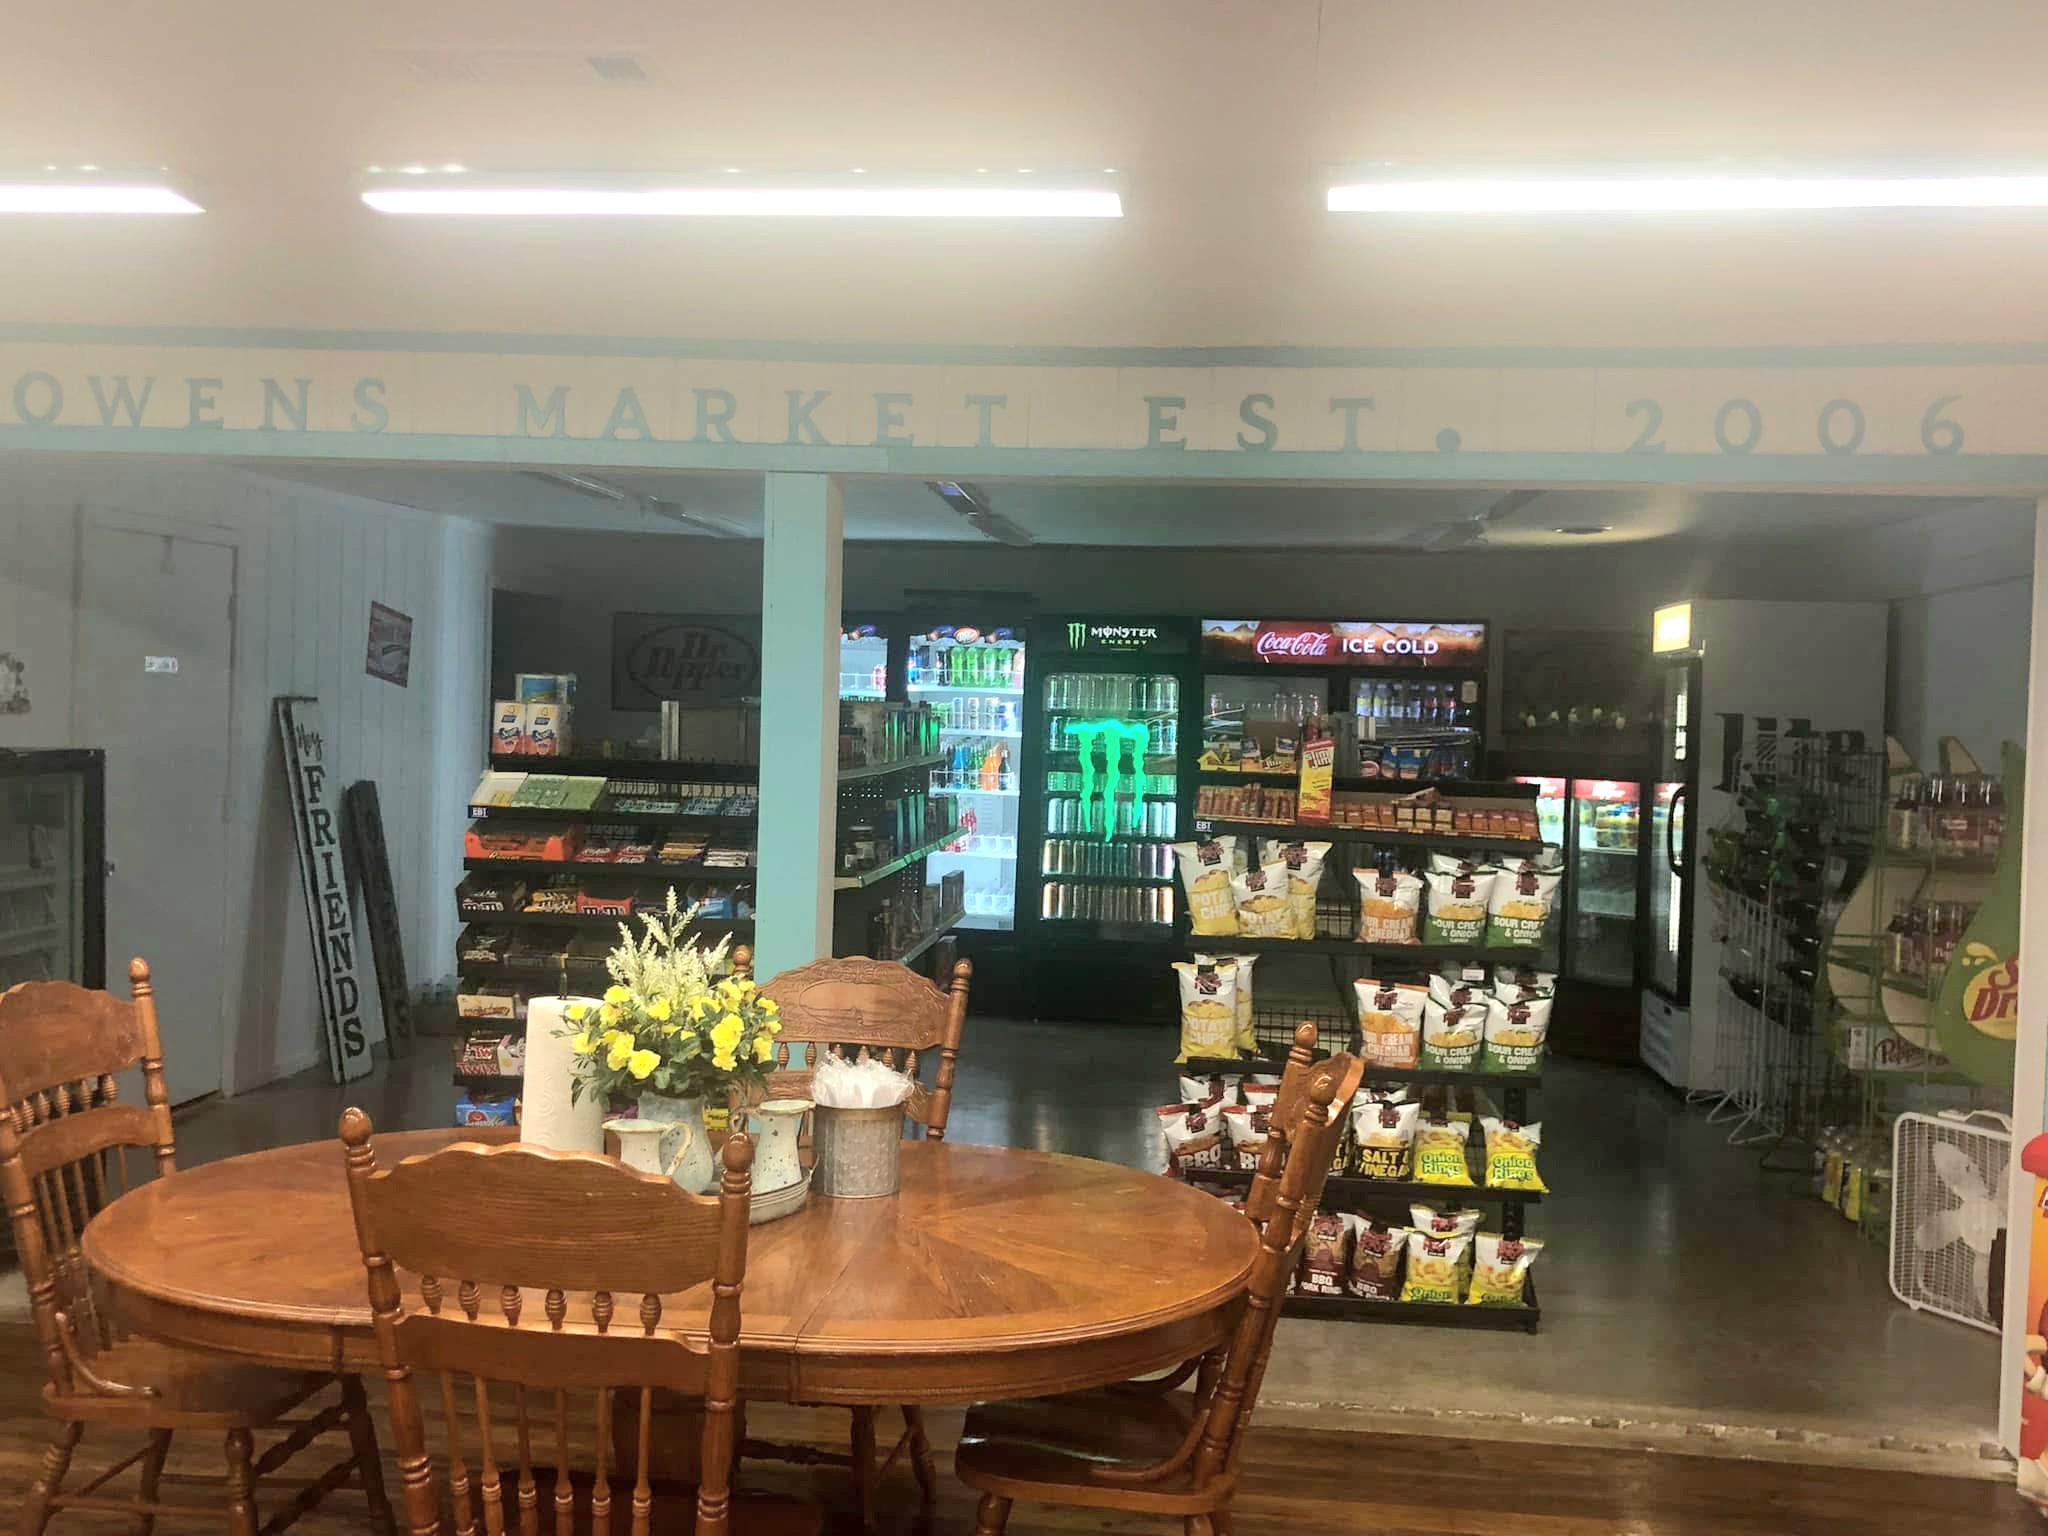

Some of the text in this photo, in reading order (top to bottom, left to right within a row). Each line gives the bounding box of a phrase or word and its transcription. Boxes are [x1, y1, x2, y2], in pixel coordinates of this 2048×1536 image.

[12, 371, 1965, 456] OWENS MARKET EST. 2006
[1342, 638, 1376, 653] ICE
[1382, 639, 1438, 655] COLD
[1195, 821, 1212, 830] EBT
[303, 765, 366, 1059] FRIENDS
[1969, 988, 2018, 1021] Dr
[1361, 1150, 1397, 1164] SALT
[1422, 1153, 1462, 1165] Onion
[1493, 1156, 1535, 1168] Onion
